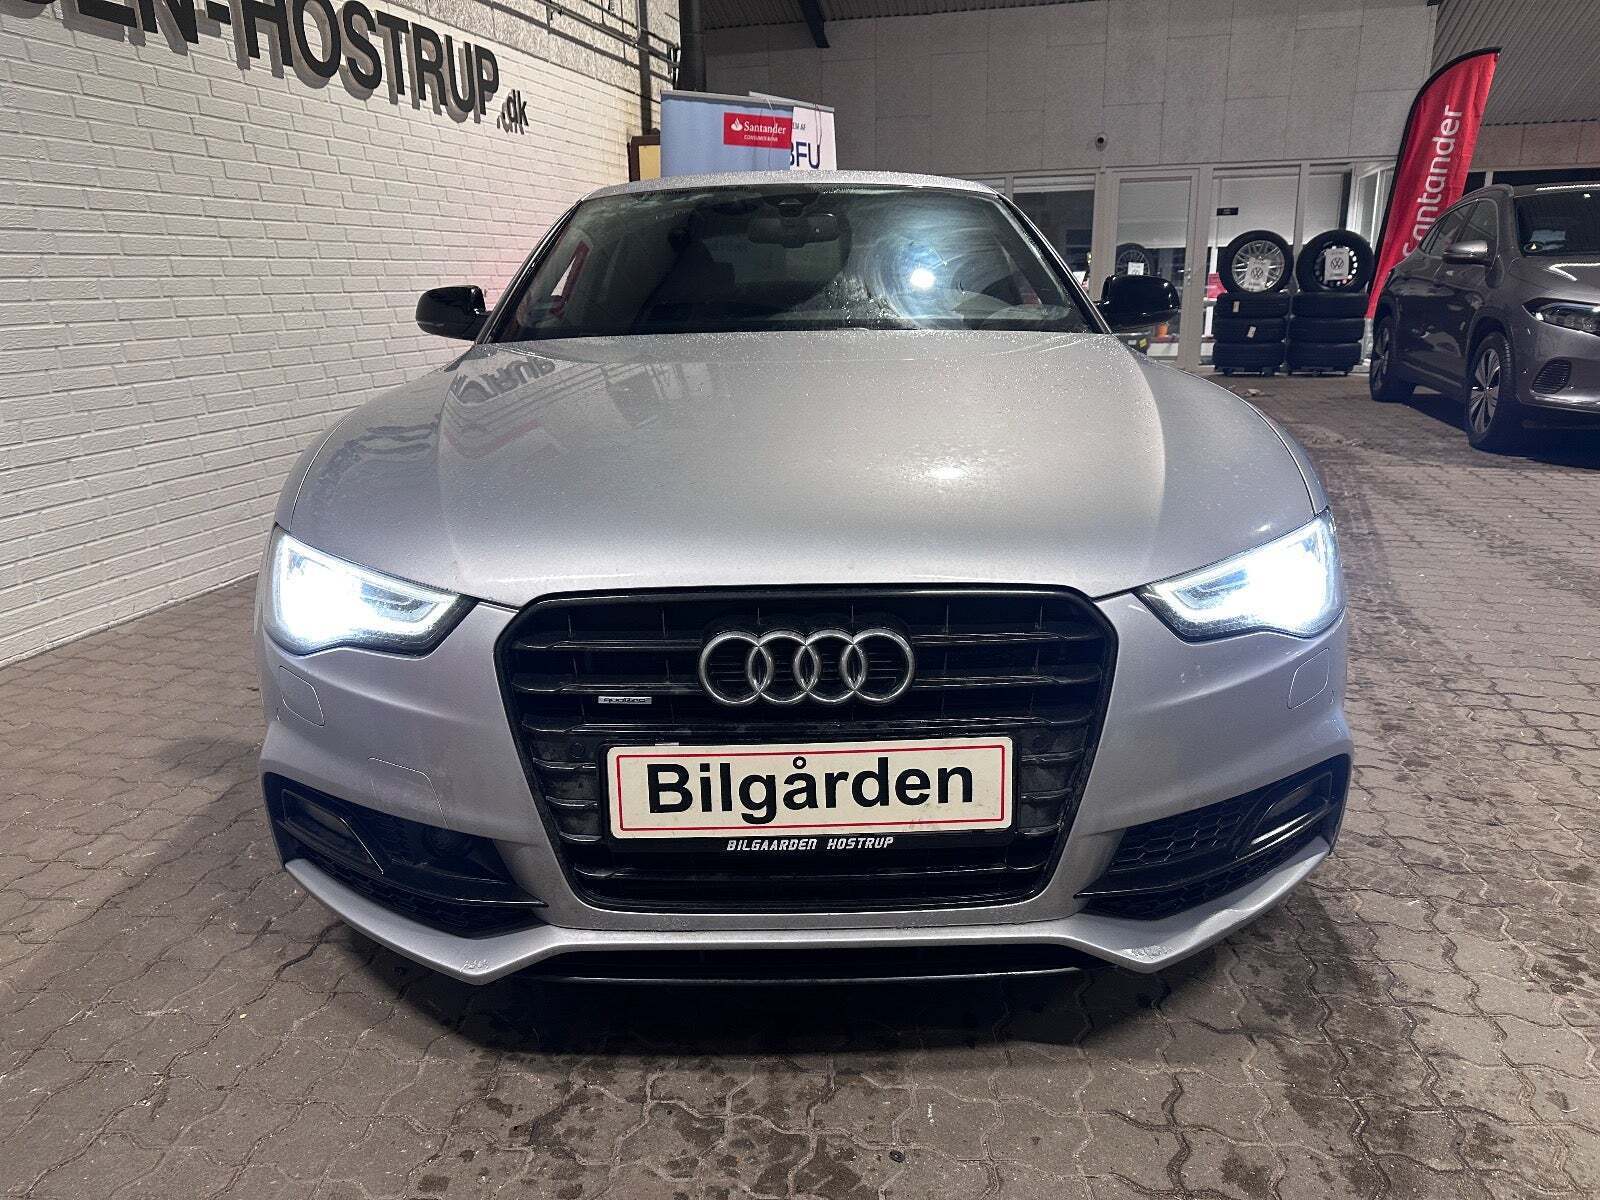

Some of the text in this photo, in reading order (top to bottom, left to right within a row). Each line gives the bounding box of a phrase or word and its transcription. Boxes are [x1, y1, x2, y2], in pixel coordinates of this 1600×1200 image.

[743, 121, 787, 134] Santander
[646, 756, 974, 825] Bilgården
[726, 836, 894, 851] BILGAARDEN HOSTRUP
